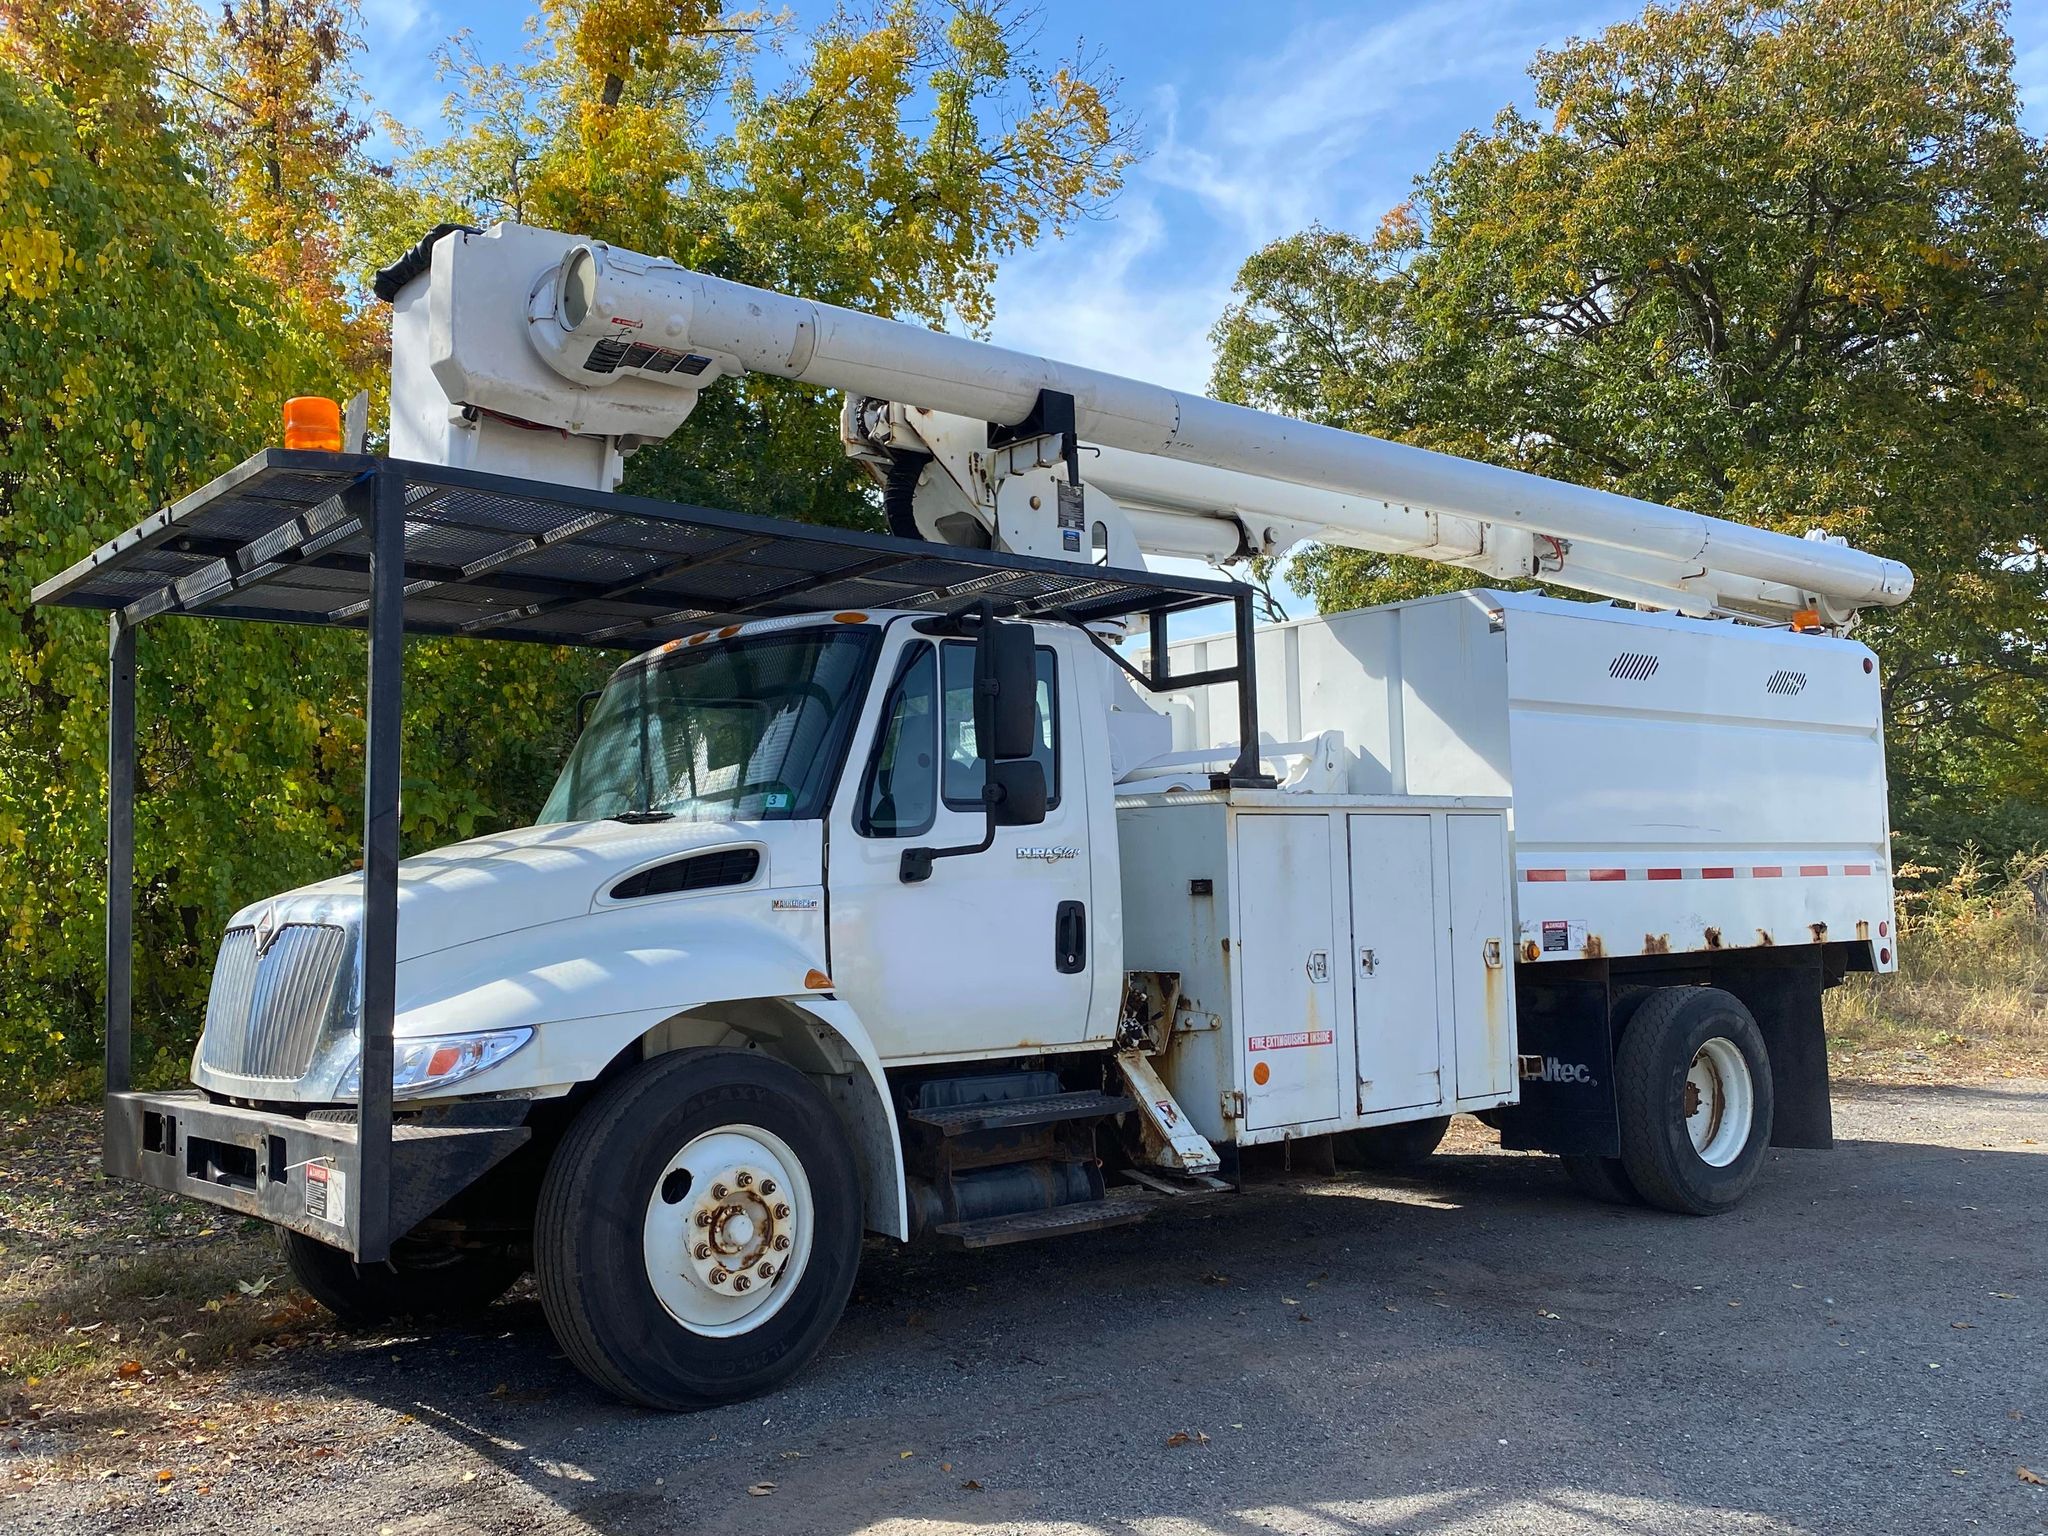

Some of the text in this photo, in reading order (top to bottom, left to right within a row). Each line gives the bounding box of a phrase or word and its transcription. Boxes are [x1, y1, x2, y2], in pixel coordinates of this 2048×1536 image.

[768, 794, 778, 806] 3
[1251, 1031, 1330, 1049] FIRE EXTINGUISHER INSIDE
